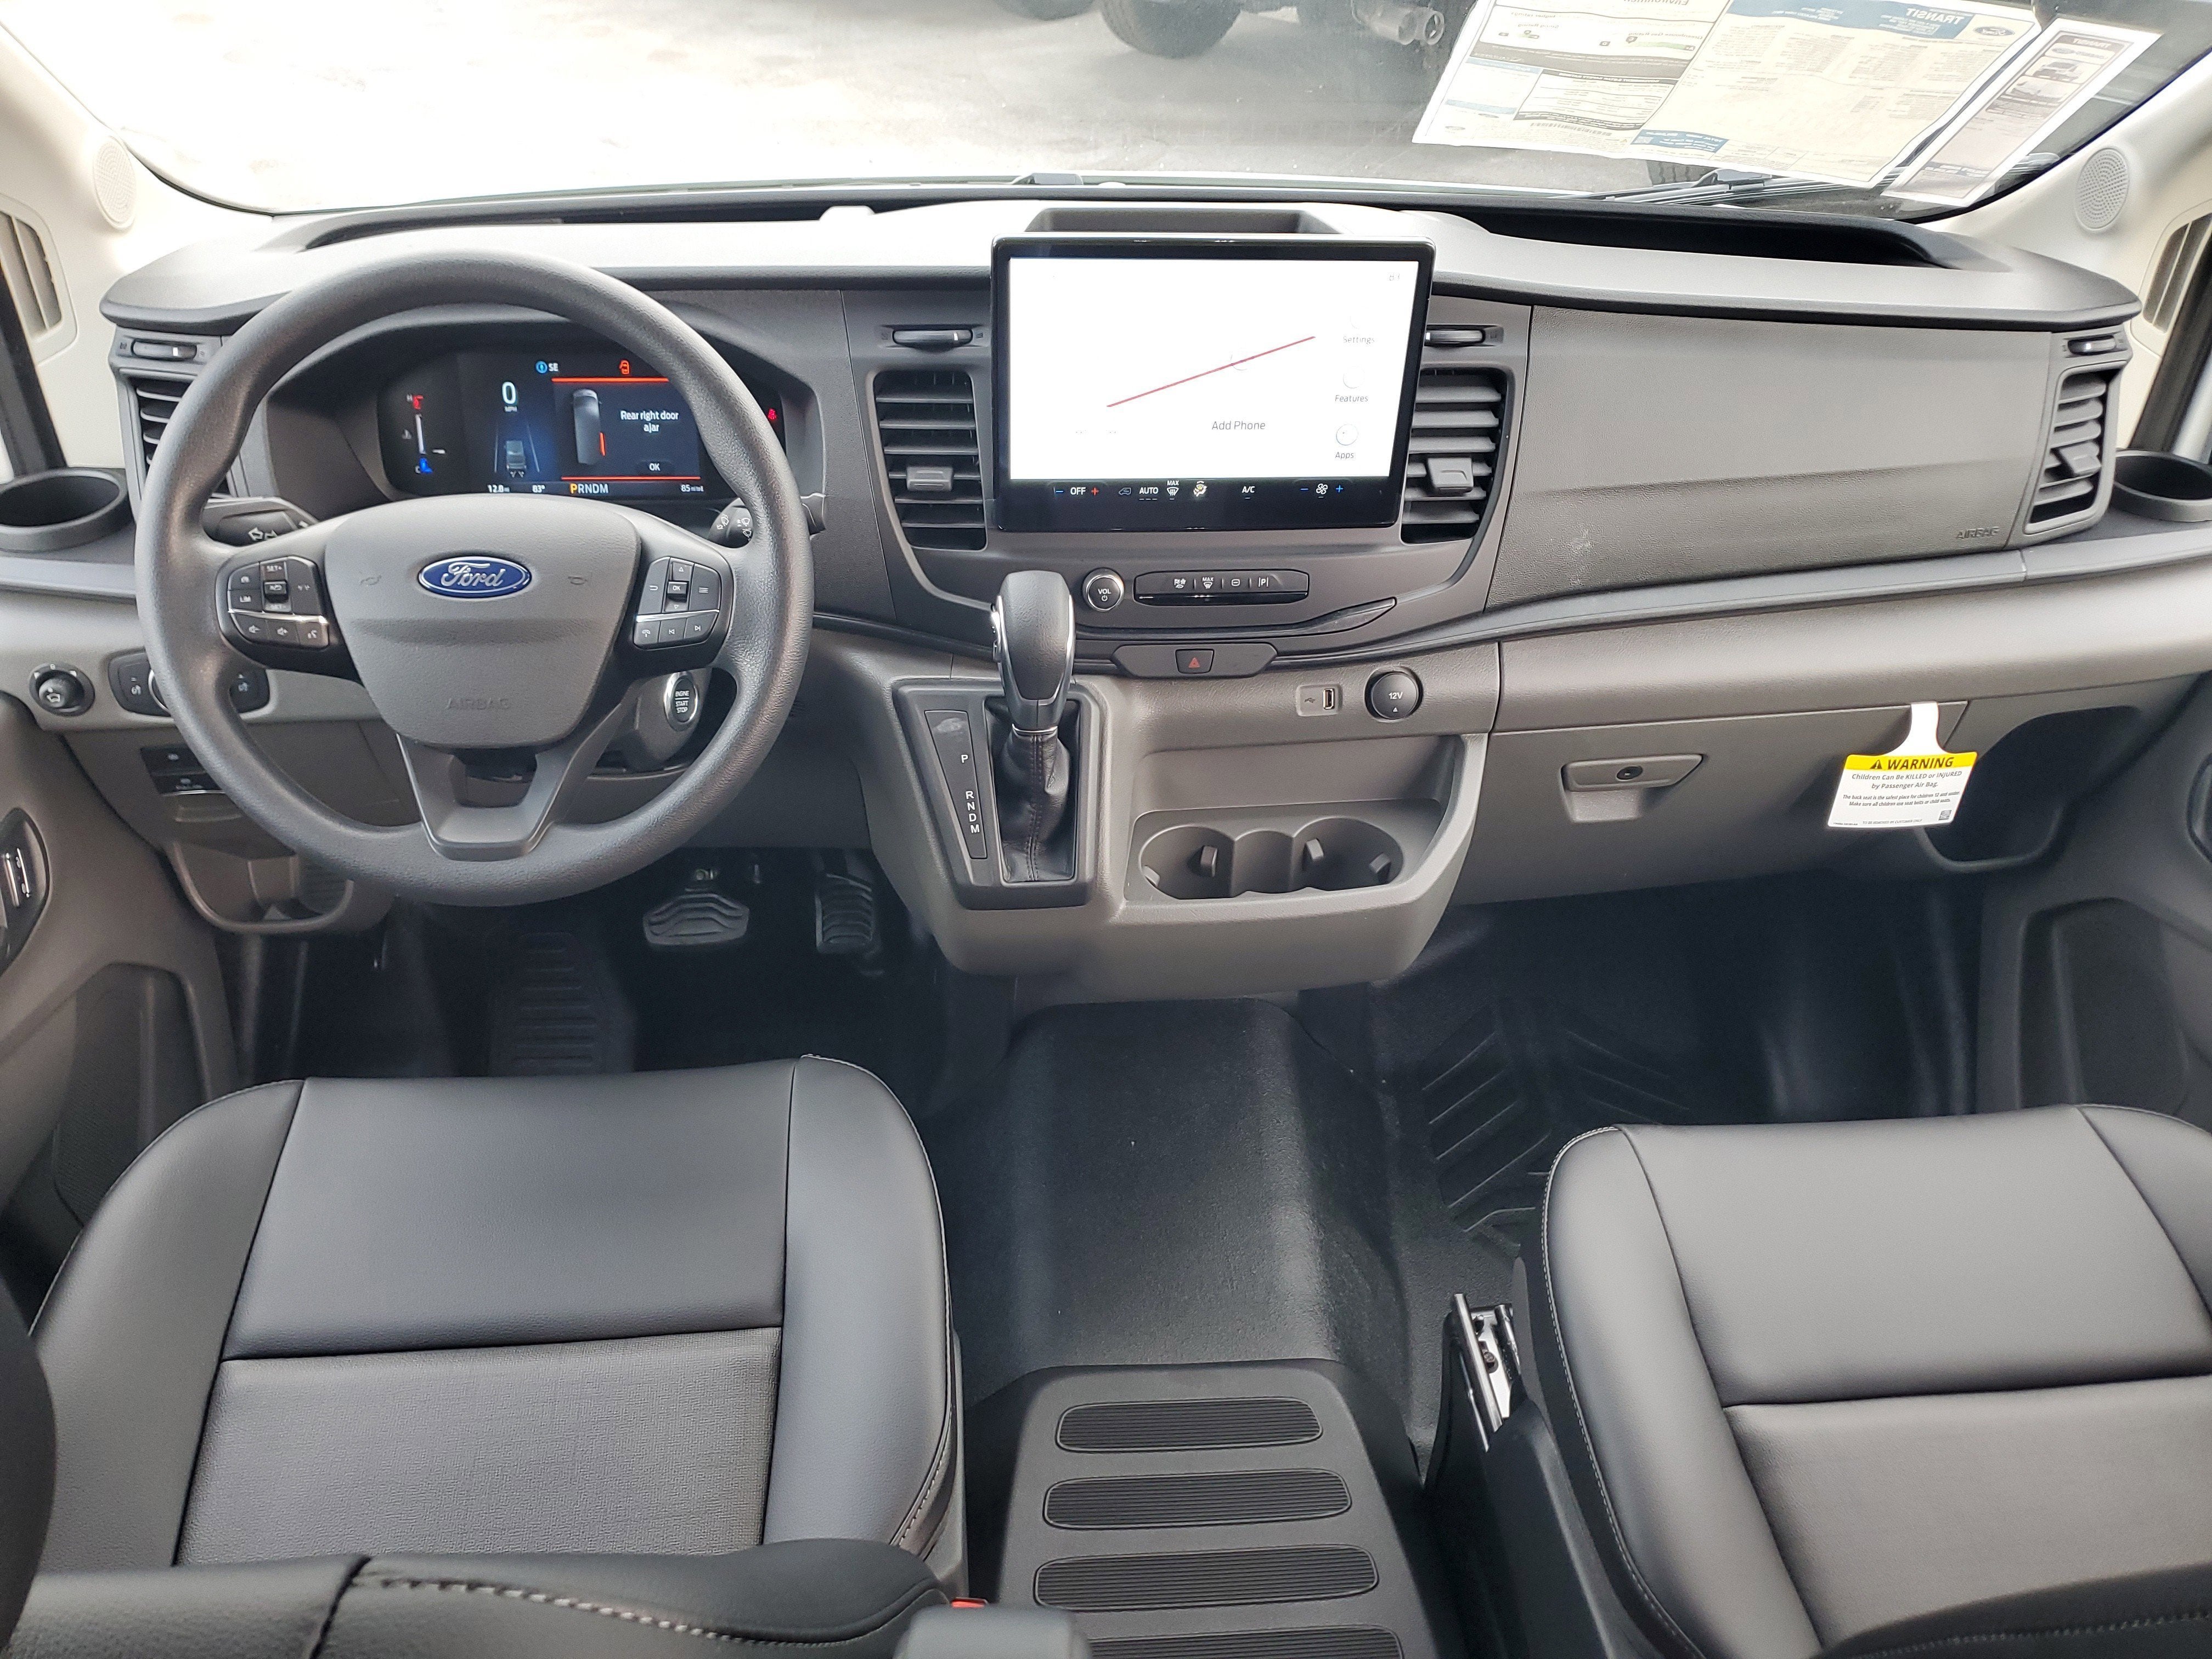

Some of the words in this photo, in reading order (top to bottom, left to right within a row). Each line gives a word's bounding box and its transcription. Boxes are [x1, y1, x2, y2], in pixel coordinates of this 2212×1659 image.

[1342, 336, 1375, 345] Settings
[549, 363, 558, 371] SE
[502, 381, 516, 404] 0
[1335, 394, 1369, 403] Features
[620, 410, 639, 420] Rear
[640, 410, 659, 421] right
[660, 410, 679, 420] door
[643, 423, 660, 433] ajar
[1211, 421, 1232, 430] Add
[1234, 421, 1266, 430] Phone
[1335, 452, 1354, 460] Apps
[649, 463, 661, 471] OK
[1070, 487, 1087, 495] OFF
[441, 562, 506, 586] Ford
[961, 754, 969, 763] P
[1887, 757, 1955, 770] WARNING
[966, 791, 974, 799] R
[967, 802, 975, 811] N
[969, 813, 977, 822] D
[970, 824, 980, 833] M
